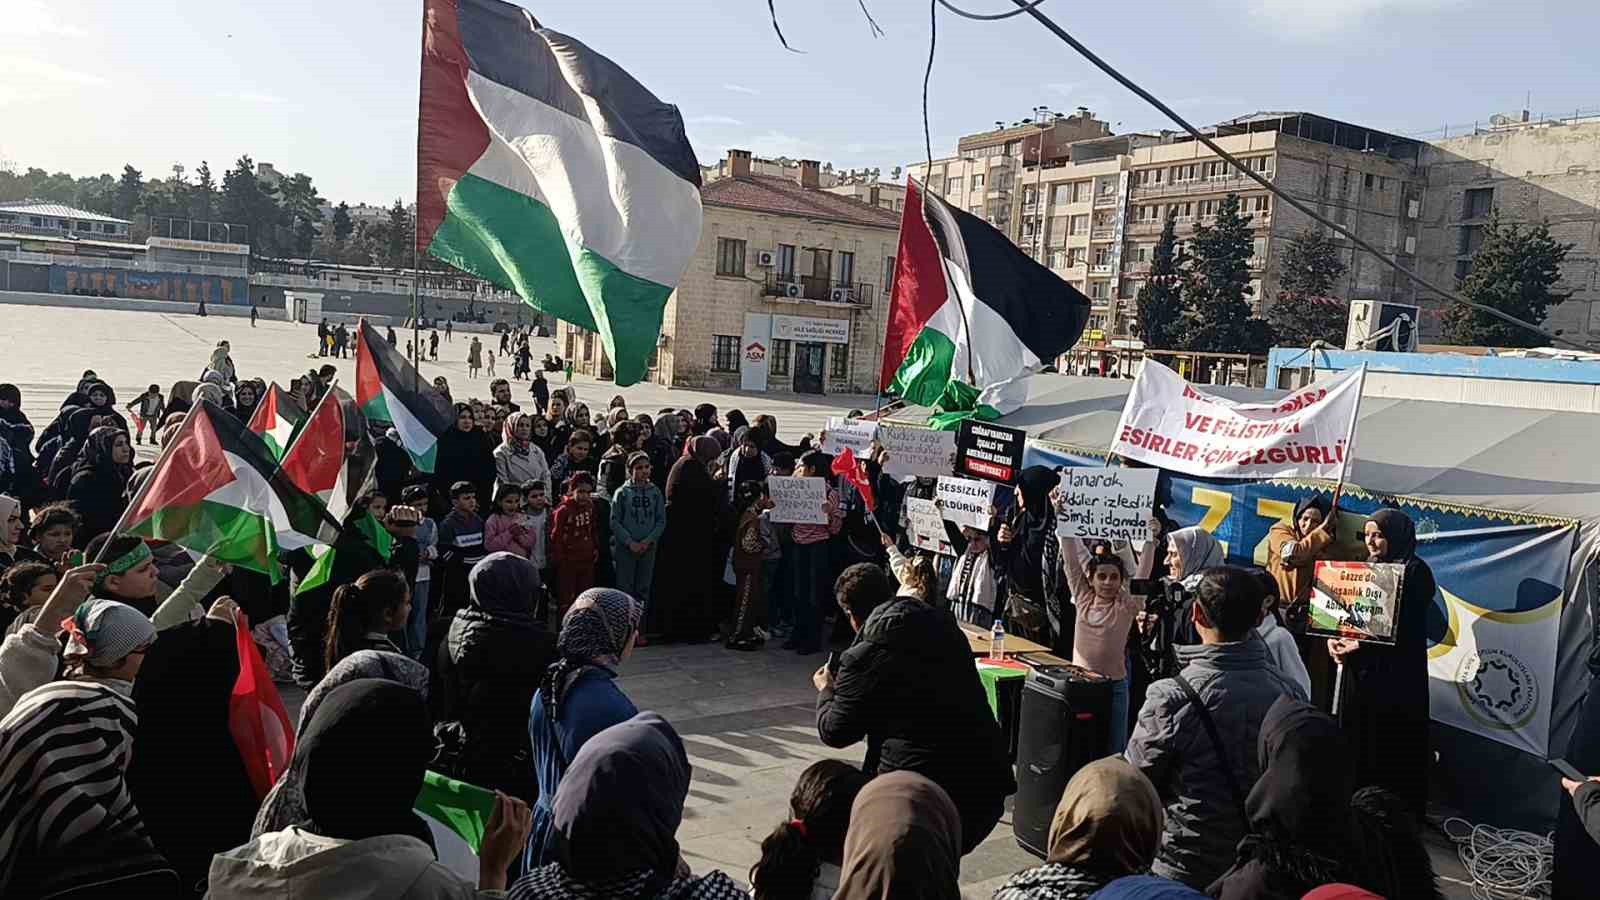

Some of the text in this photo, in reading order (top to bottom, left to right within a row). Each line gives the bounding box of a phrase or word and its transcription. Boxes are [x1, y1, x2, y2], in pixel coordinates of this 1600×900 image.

[745, 351, 765, 361] ASM
[1185, 411, 1212, 433] VE
[1119, 424, 1199, 461] ESİRLER
[1236, 438, 1347, 466] ÖZGÜRLÜ
